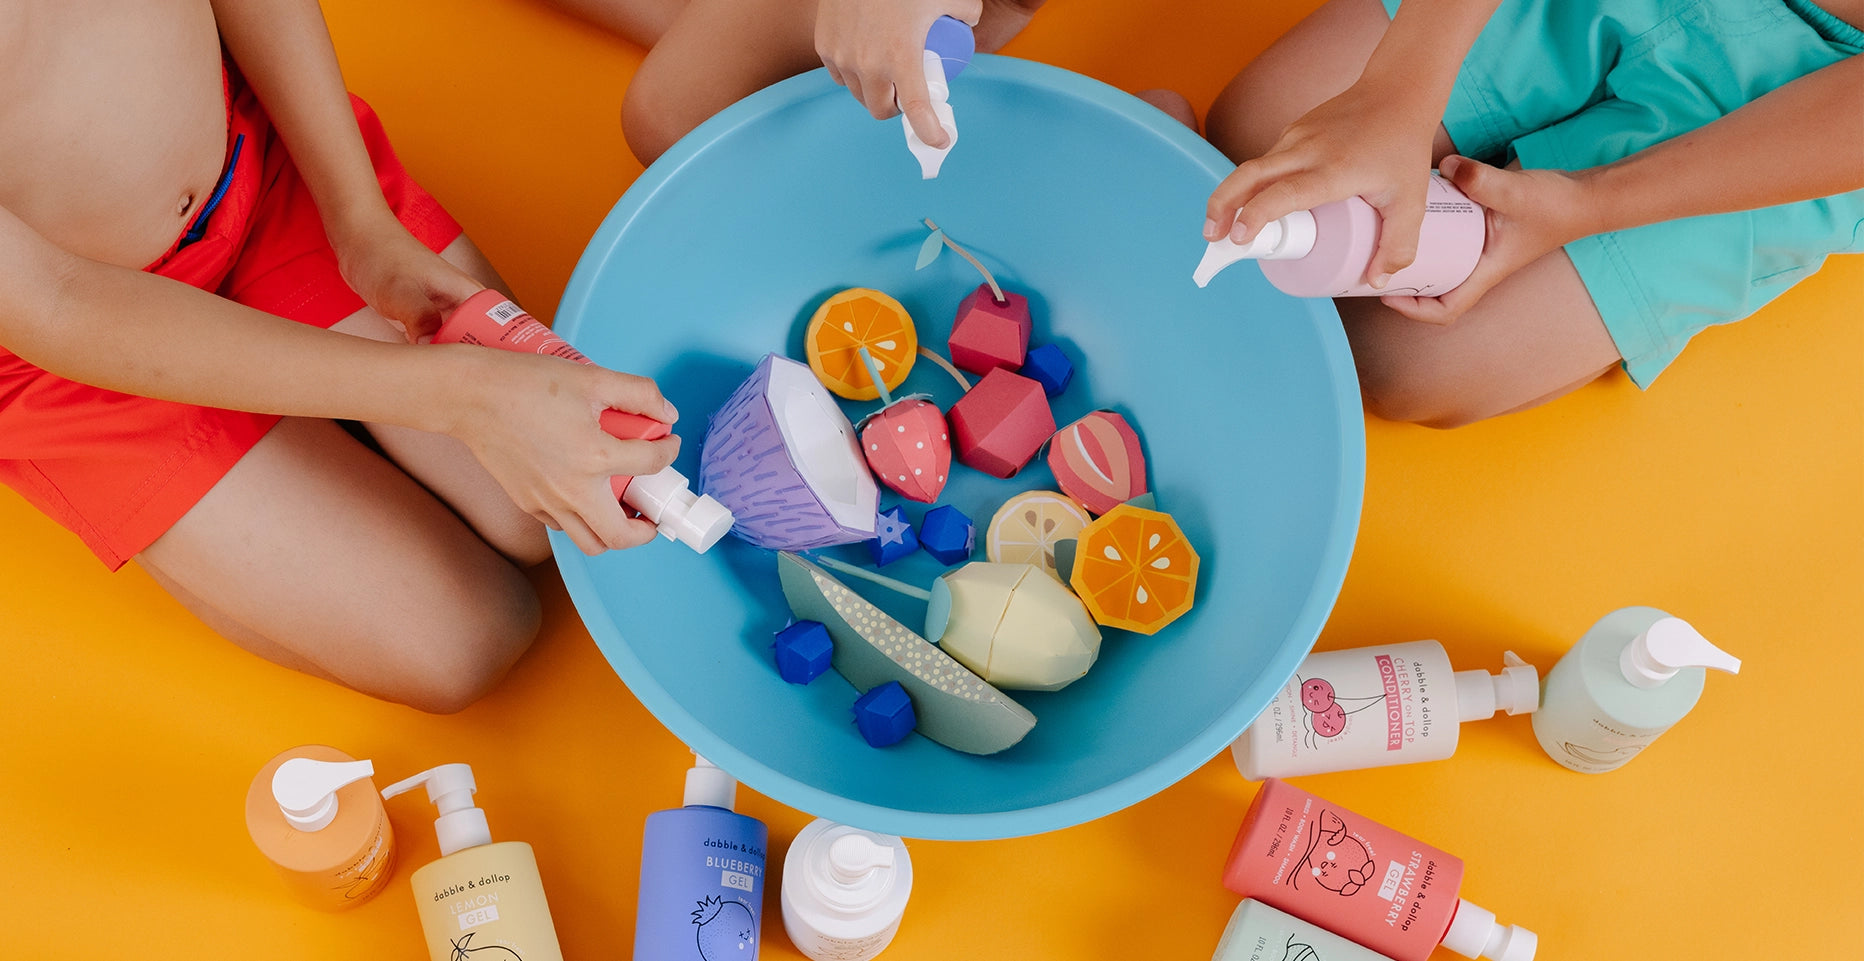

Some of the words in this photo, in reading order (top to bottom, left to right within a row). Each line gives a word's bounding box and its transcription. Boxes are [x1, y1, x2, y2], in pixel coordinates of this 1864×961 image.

[1394, 658, 1413, 703] CHERRY
[1413, 661, 1426, 693] dabble
[1379, 658, 1402, 746] CONDITIONER
[1405, 704, 1413, 718] ON
[1421, 696, 1430, 704] &
[1405, 720, 1415, 743] TOP
[1422, 706, 1432, 738] dollop
[704, 838, 738, 851] dabble
[741, 844, 747, 852] &
[1267, 838, 1281, 858] 296mL
[706, 857, 762, 877] BLUEBERRY
[1421, 860, 1436, 889] dabble
[434, 884, 465, 902] dabble
[468, 881, 475, 889] &
[478, 874, 511, 886] dollop
[729, 875, 748, 888] GEL
[1384, 868, 1399, 891] GEL
[1384, 850, 1422, 926] STRAWBERRY
[450, 892, 499, 914] LEMON
[1416, 892, 1427, 900] &
[466, 909, 492, 925] GEL
[1401, 901, 1422, 932] dollop
[1259, 936, 1266, 945] 10
